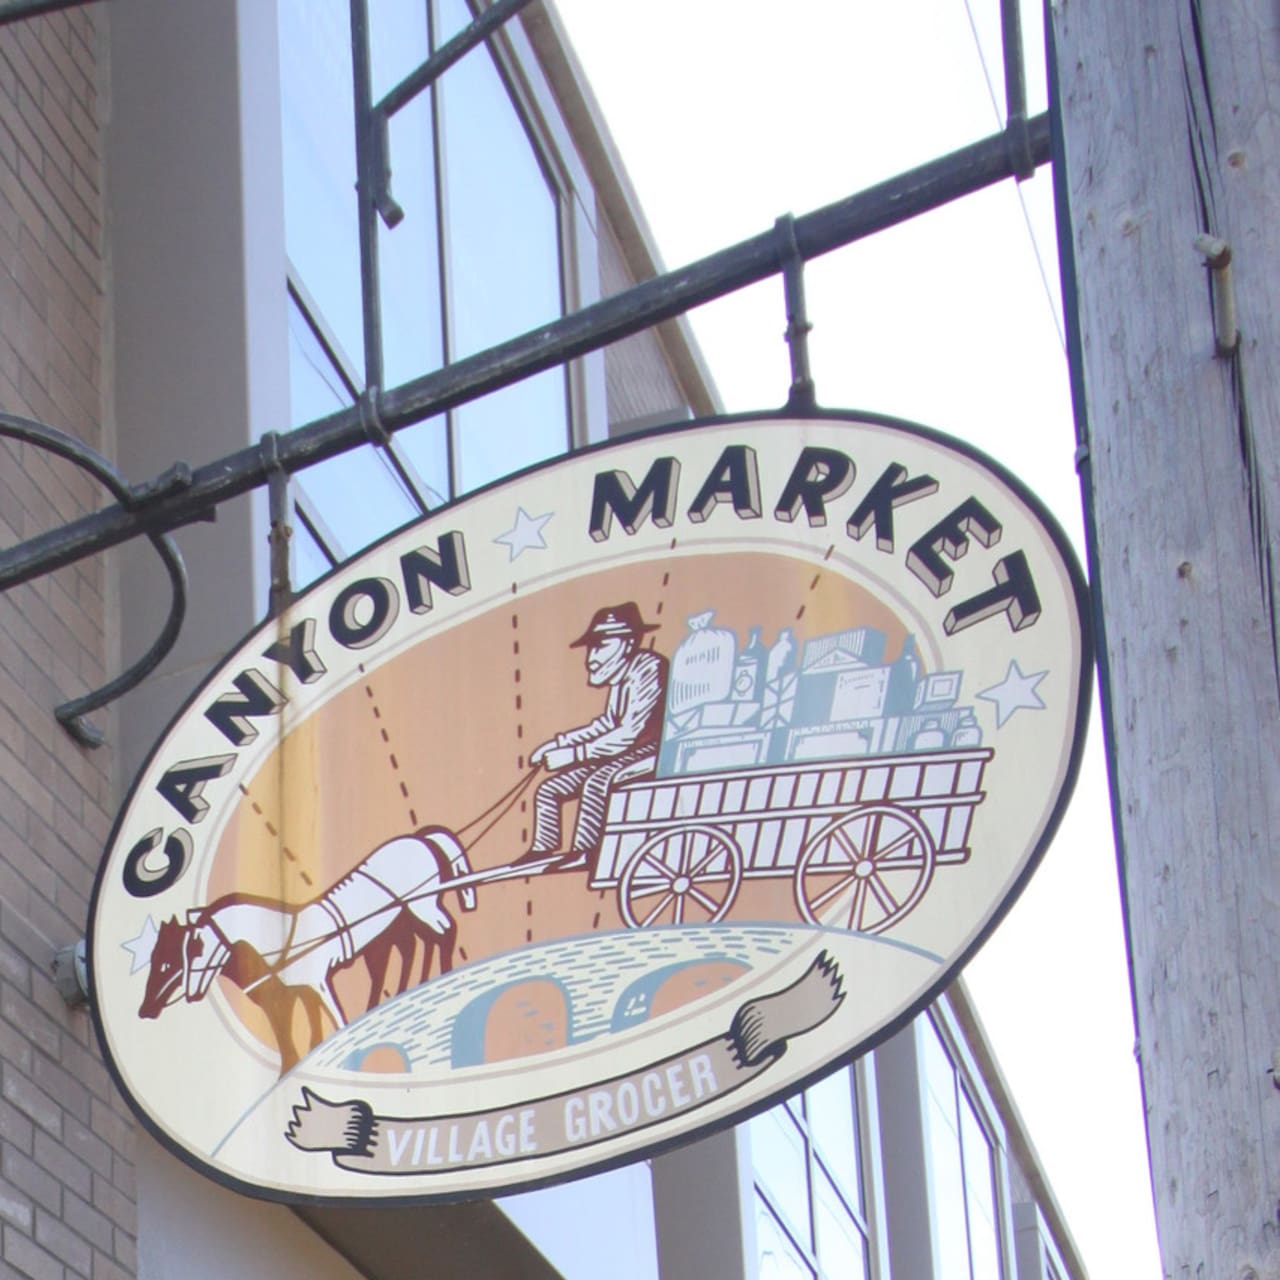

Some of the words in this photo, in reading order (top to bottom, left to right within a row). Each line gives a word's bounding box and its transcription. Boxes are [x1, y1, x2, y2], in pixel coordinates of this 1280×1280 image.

[123, 530, 471, 898] CANYON
[589, 444, 1042, 637] MARKET
[386, 1109, 537, 1167] VILLAGE
[564, 1053, 719, 1143] GROCER
